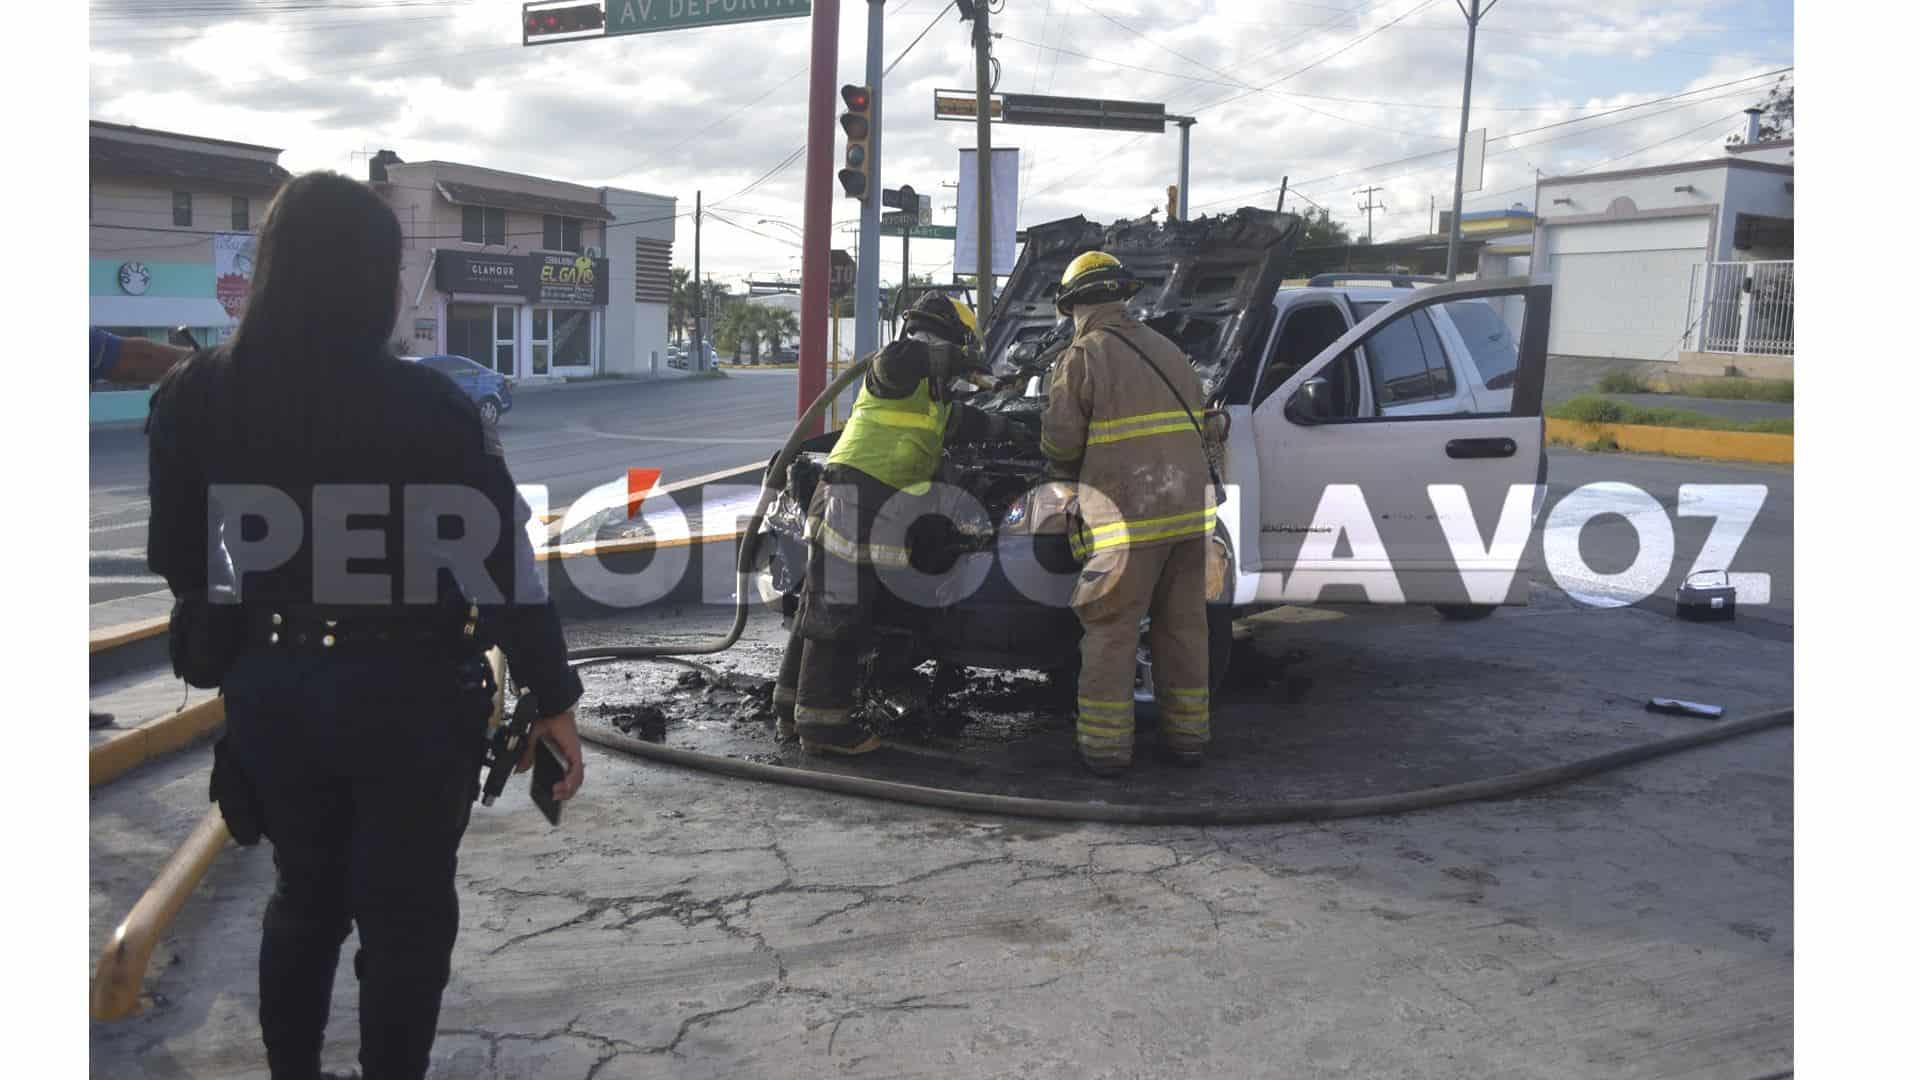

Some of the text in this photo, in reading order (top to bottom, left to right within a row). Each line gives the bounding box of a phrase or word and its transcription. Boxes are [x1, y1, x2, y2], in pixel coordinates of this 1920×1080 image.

[620, 0, 810, 24] AV. DEPOR
[471, 264, 515, 276] GLAMOUR
[541, 265, 557, 282] EL
